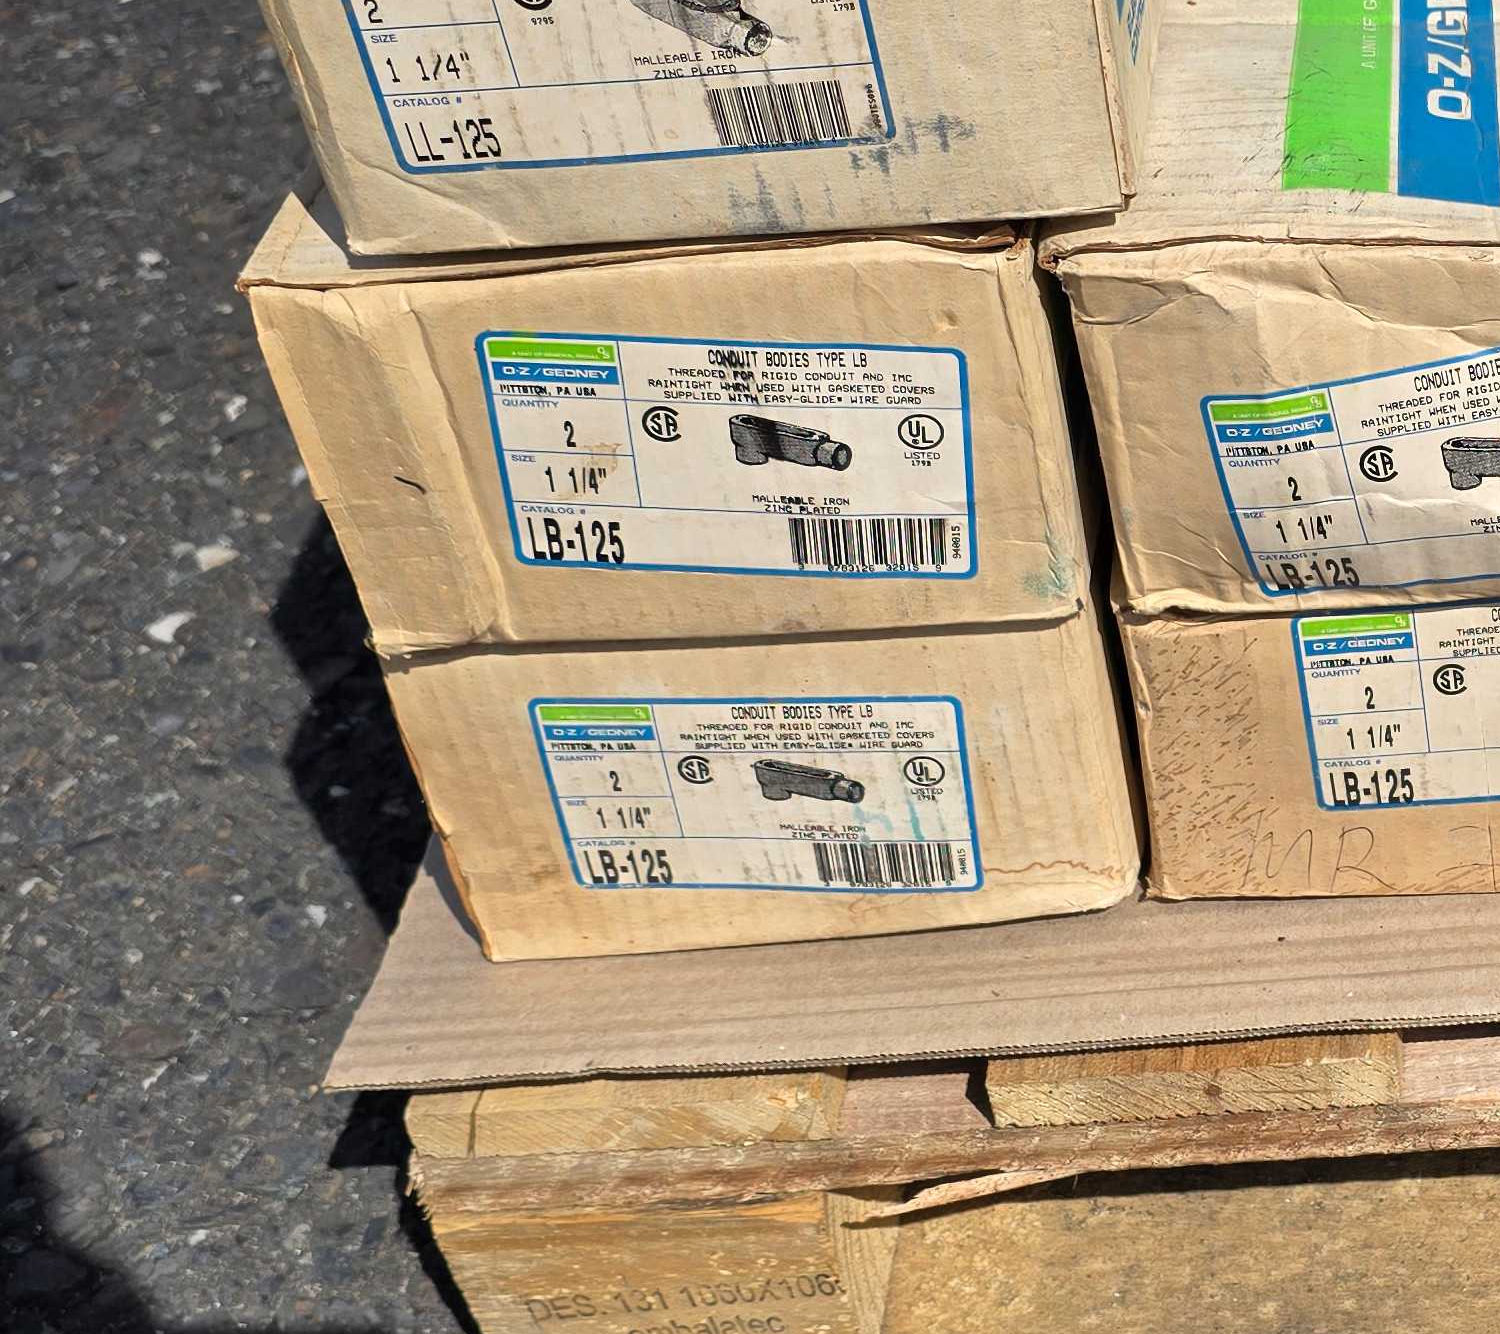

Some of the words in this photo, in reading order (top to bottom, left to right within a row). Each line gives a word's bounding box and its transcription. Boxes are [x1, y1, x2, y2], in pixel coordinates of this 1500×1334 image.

[371, 34, 398, 43] SIZE
[633, 52, 702, 67] MALLEABLE
[386, 58, 400, 82] 1
[416, 52, 470, 80] 1/4"
[691, 64, 737, 76] PLATED
[393, 96, 450, 108] CATALOG
[405, 118, 502, 162] LL-125
[765, 352, 808, 367] BODIES
[816, 352, 848, 368] TYPE
[853, 353, 867, 368] LB
[649, 379, 716, 390] RAINTIGHT
[502, 398, 559, 410] QUANTITY
[663, 391, 722, 401] SUPPLIED
[887, 395, 922, 405] GUARD
[904, 451, 940, 460] LISTED
[823, 497, 849, 506] IRON
[521, 505, 576, 515] CATALOG
[528, 518, 625, 564] LB-125
[732, 706, 776, 719] CONDUIT
[782, 706, 821, 719] BODIES
[827, 706, 854, 718] TYPE
[859, 706, 873, 718] LB
[1329, 768, 1414, 805] LB-125
[583, 851, 674, 884] LB-125
